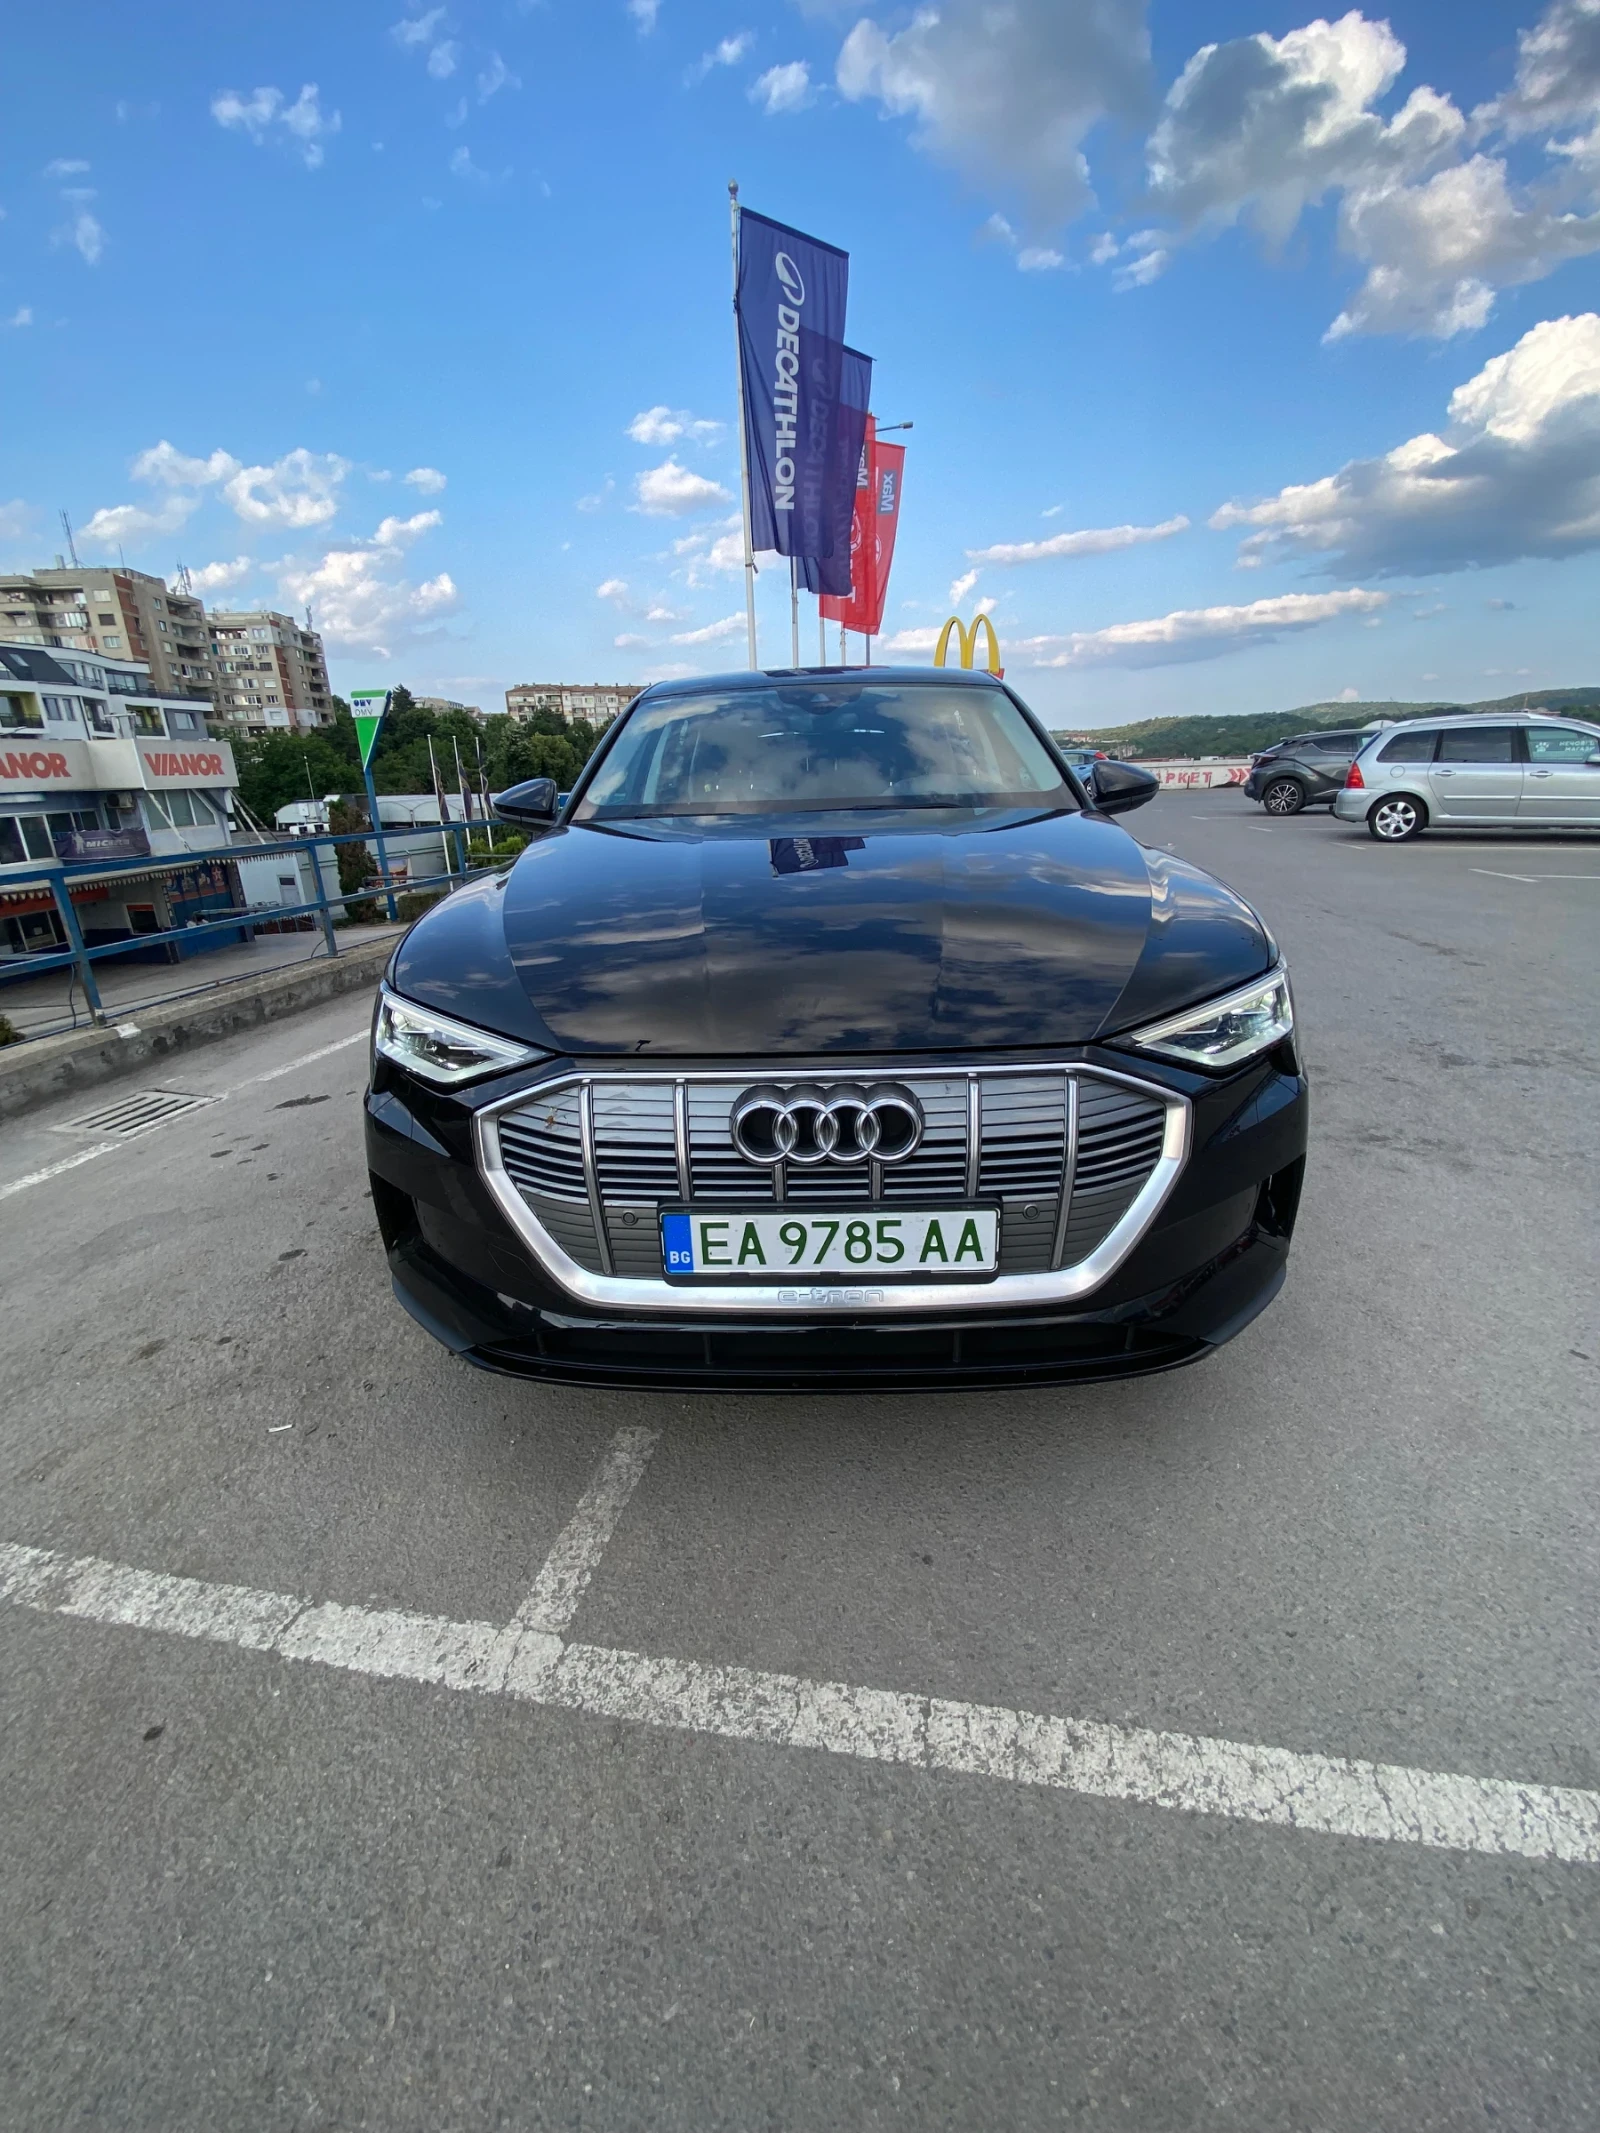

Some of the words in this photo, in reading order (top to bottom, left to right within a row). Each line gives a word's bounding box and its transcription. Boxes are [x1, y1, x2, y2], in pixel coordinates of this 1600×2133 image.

[774, 303, 800, 510] DECATHLON
[144, 753, 225, 776] VIANOR
[700, 1221, 767, 1265] EA
[779, 1219, 905, 1265] 9785
[919, 1218, 984, 1263] AA
[669, 1251, 691, 1264] BG
[777, 1288, 885, 1304] e-tron
